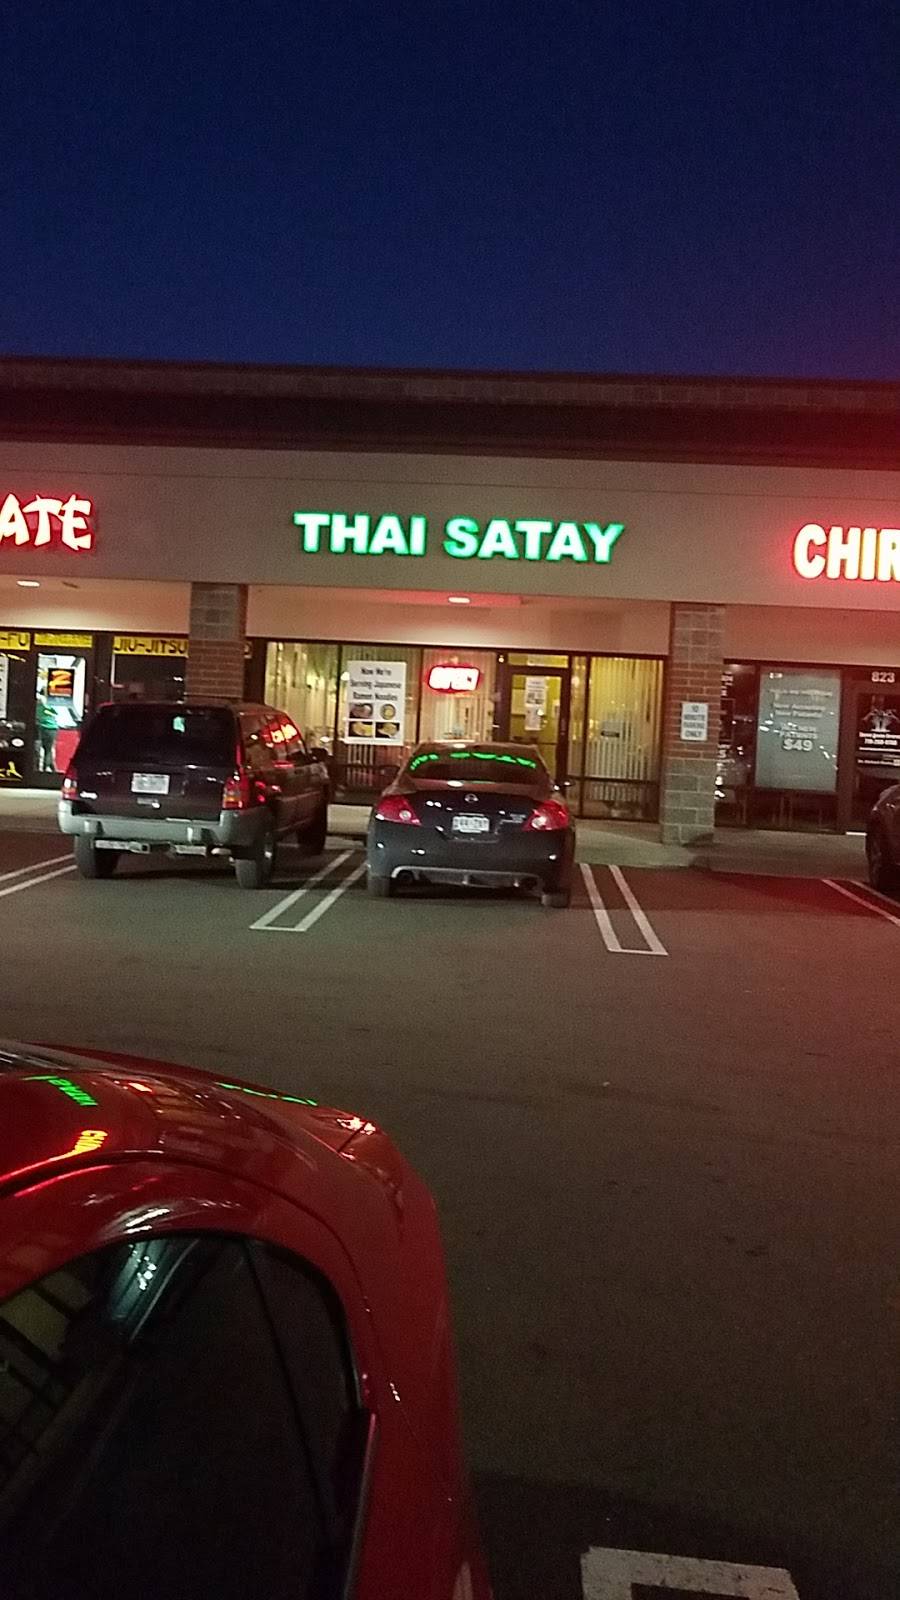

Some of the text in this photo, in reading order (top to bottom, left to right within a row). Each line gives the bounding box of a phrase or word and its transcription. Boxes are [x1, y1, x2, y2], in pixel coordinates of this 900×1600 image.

[0, 493, 92, 551] ATE
[294, 512, 625, 563] THAI SATAY
[793, 523, 900, 582] CHIR
[115, 637, 189, 654] JIU-JITSU
[871, 671, 896, 683] 823
[782, 738, 814, 751] $49
